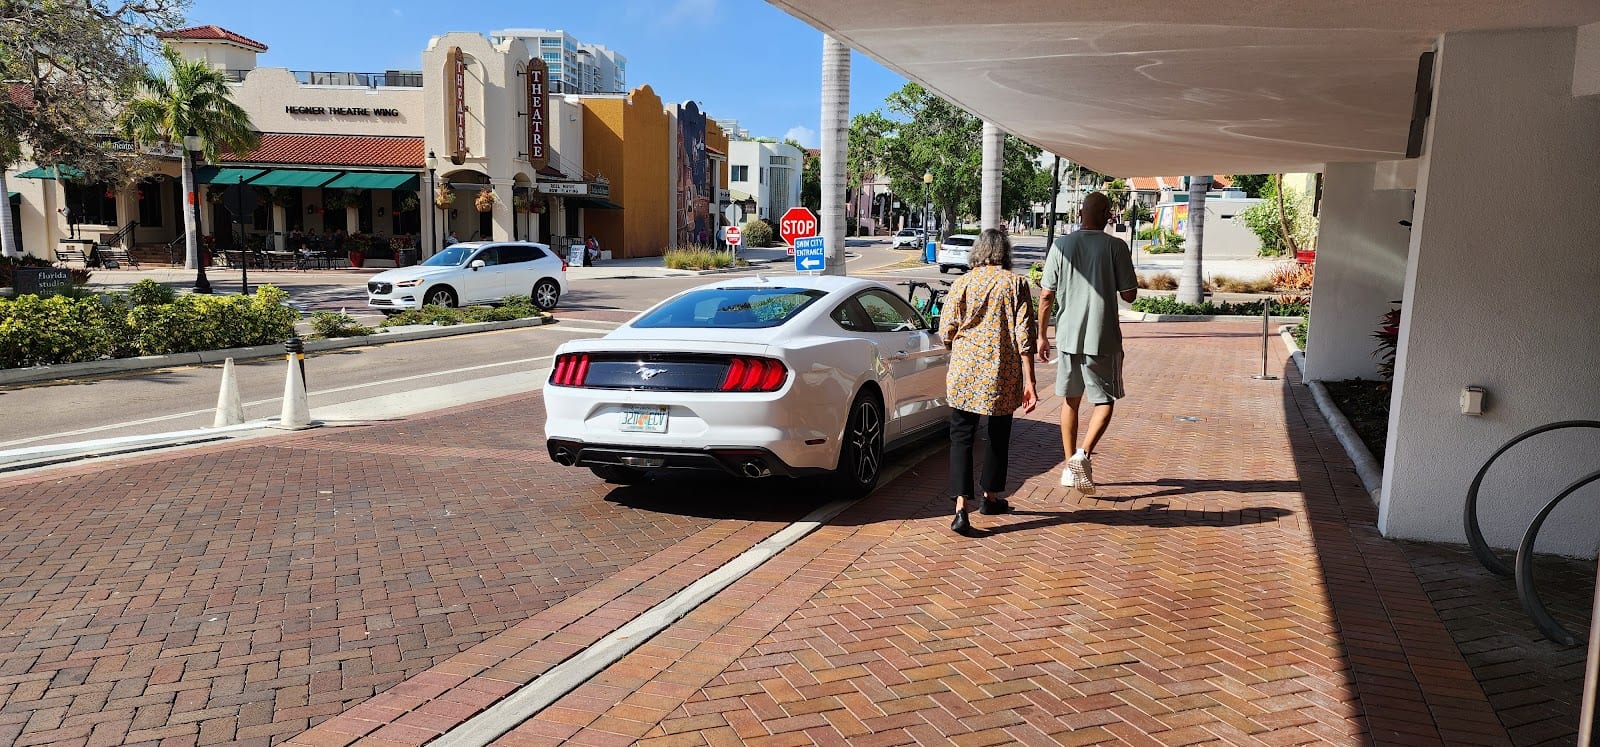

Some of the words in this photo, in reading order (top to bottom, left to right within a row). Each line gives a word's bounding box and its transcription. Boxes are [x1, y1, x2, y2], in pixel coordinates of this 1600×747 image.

[285, 105, 325, 115] HEGNER
[328, 106, 370, 117] THEATRE
[373, 107, 399, 117] WING
[456, 60, 464, 152] THEATRE
[531, 70, 543, 158] THEATRE
[782, 219, 814, 235] STOP
[810, 238, 823, 248] CITY
[796, 247, 823, 257] ENTRANCE
[38, 271, 67, 280] florida
